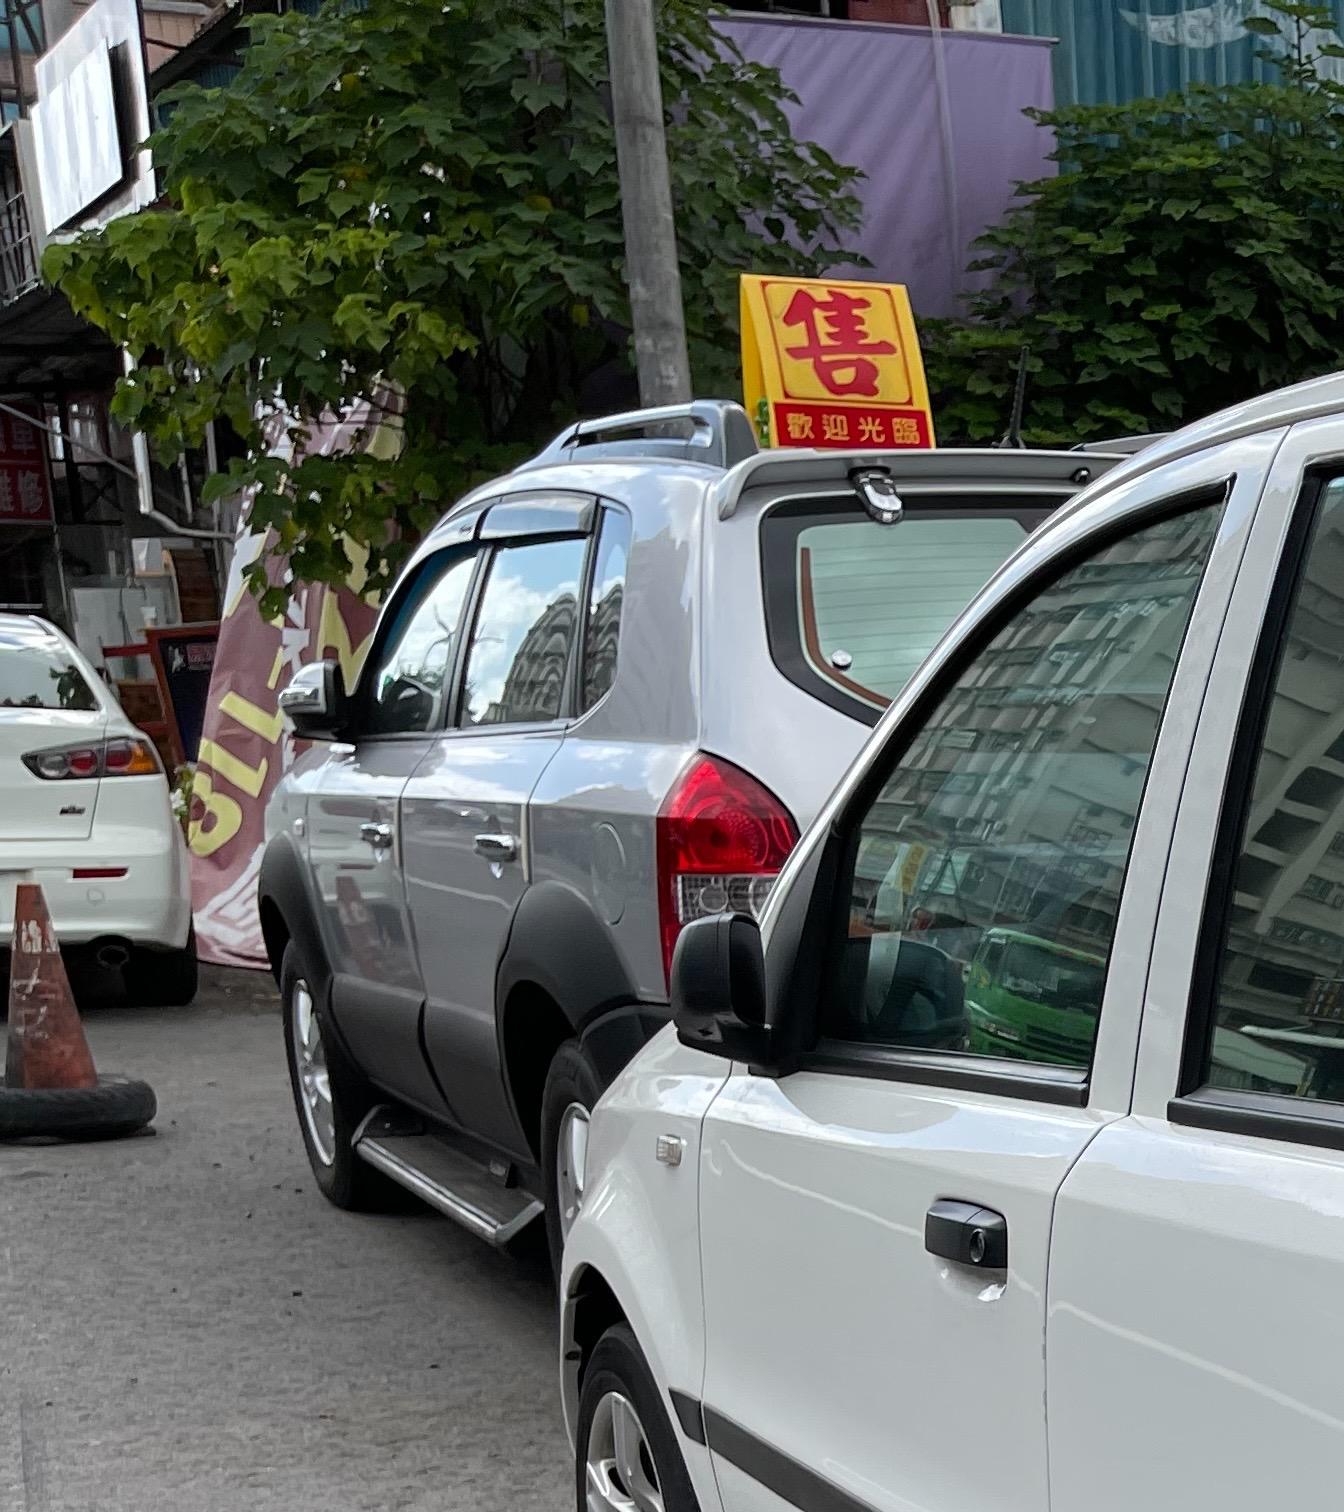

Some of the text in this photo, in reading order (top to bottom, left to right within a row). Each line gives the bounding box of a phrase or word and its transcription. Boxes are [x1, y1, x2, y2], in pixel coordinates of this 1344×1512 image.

[783, 287, 896, 398] 售
[786, 409, 921, 446] 歡迎光臨
